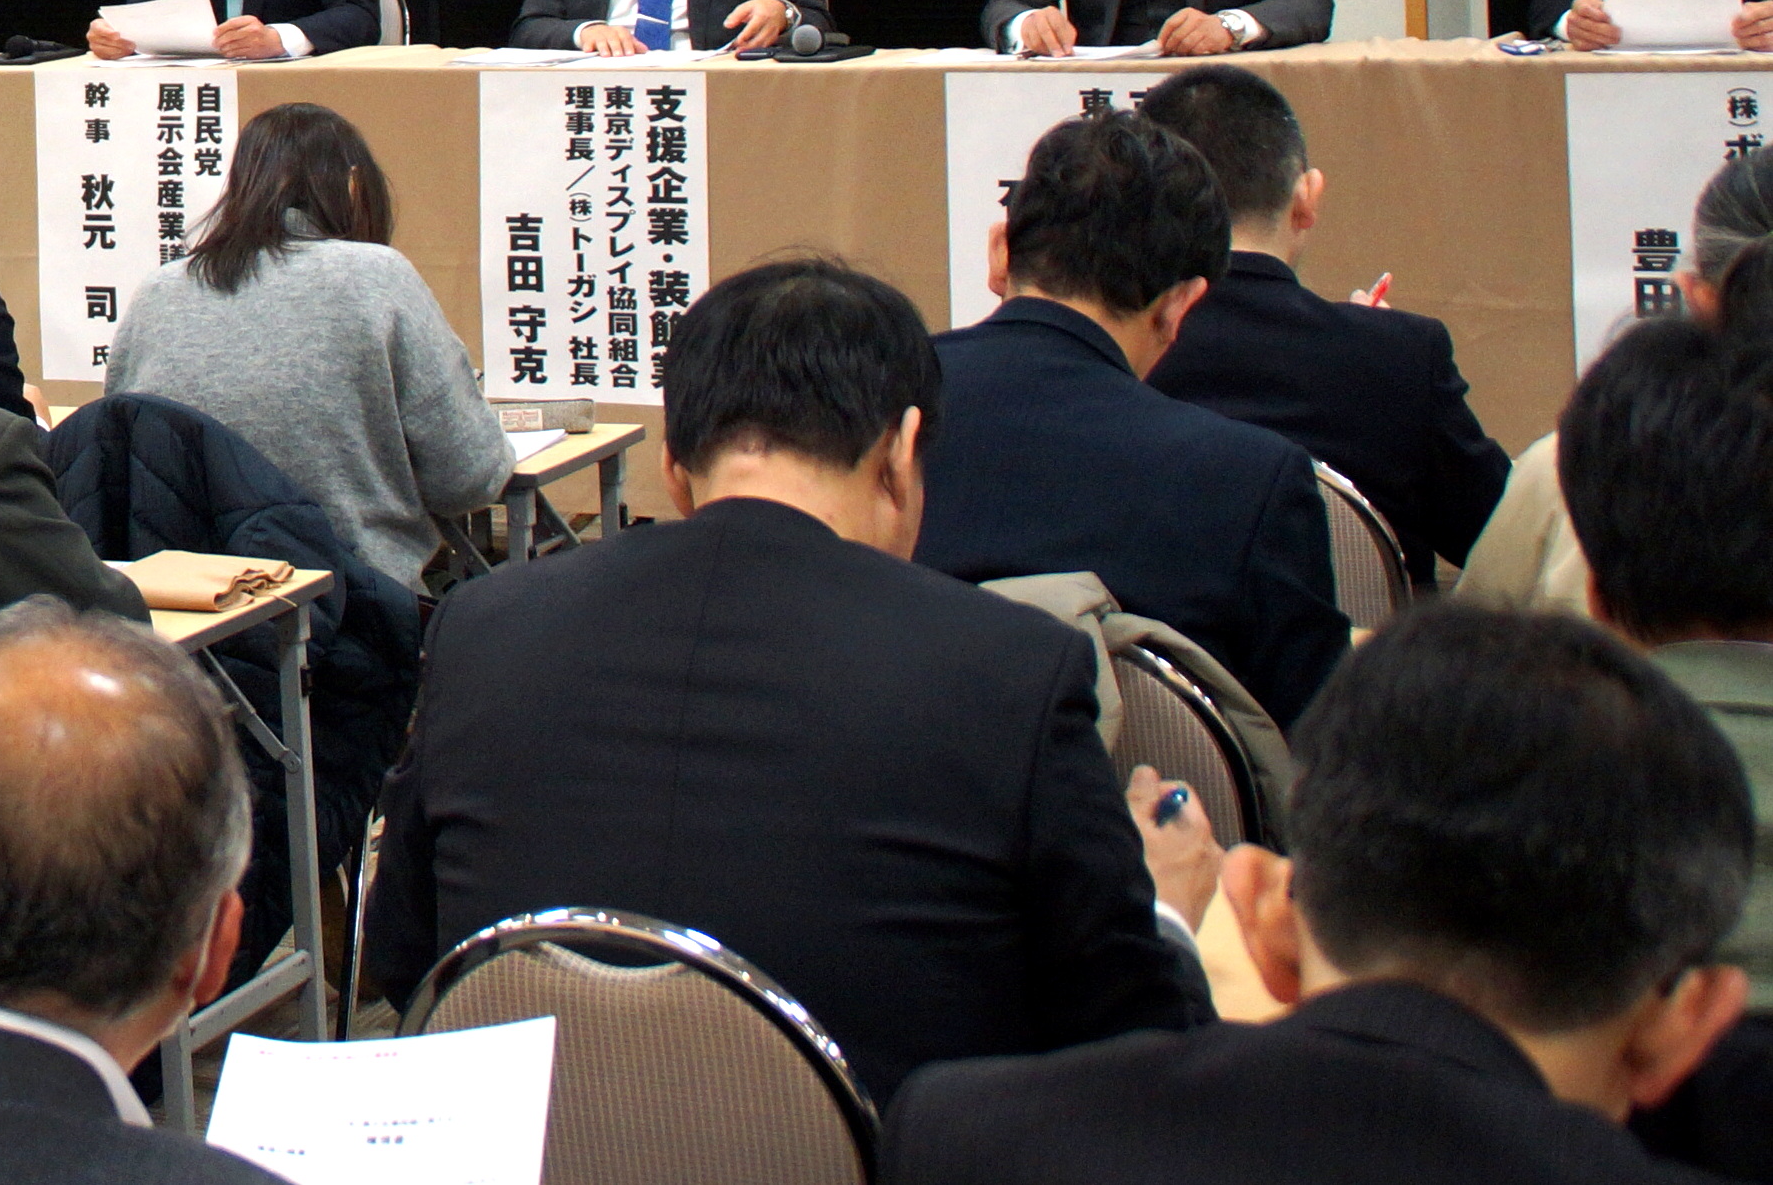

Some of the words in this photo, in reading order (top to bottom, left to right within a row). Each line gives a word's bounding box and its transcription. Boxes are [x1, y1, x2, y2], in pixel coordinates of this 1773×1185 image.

[84, 82, 110, 143] 幹事
[195, 83, 223, 176] 自民党
[81, 174, 116, 249] 秋元
[604, 85, 639, 389] 東京ディスプレイ協同組合
[506, 213, 544, 293] 吉田
[85, 286, 117, 323] 司
[508, 305, 548, 385] 守克
[569, 336, 599, 387] 社長
